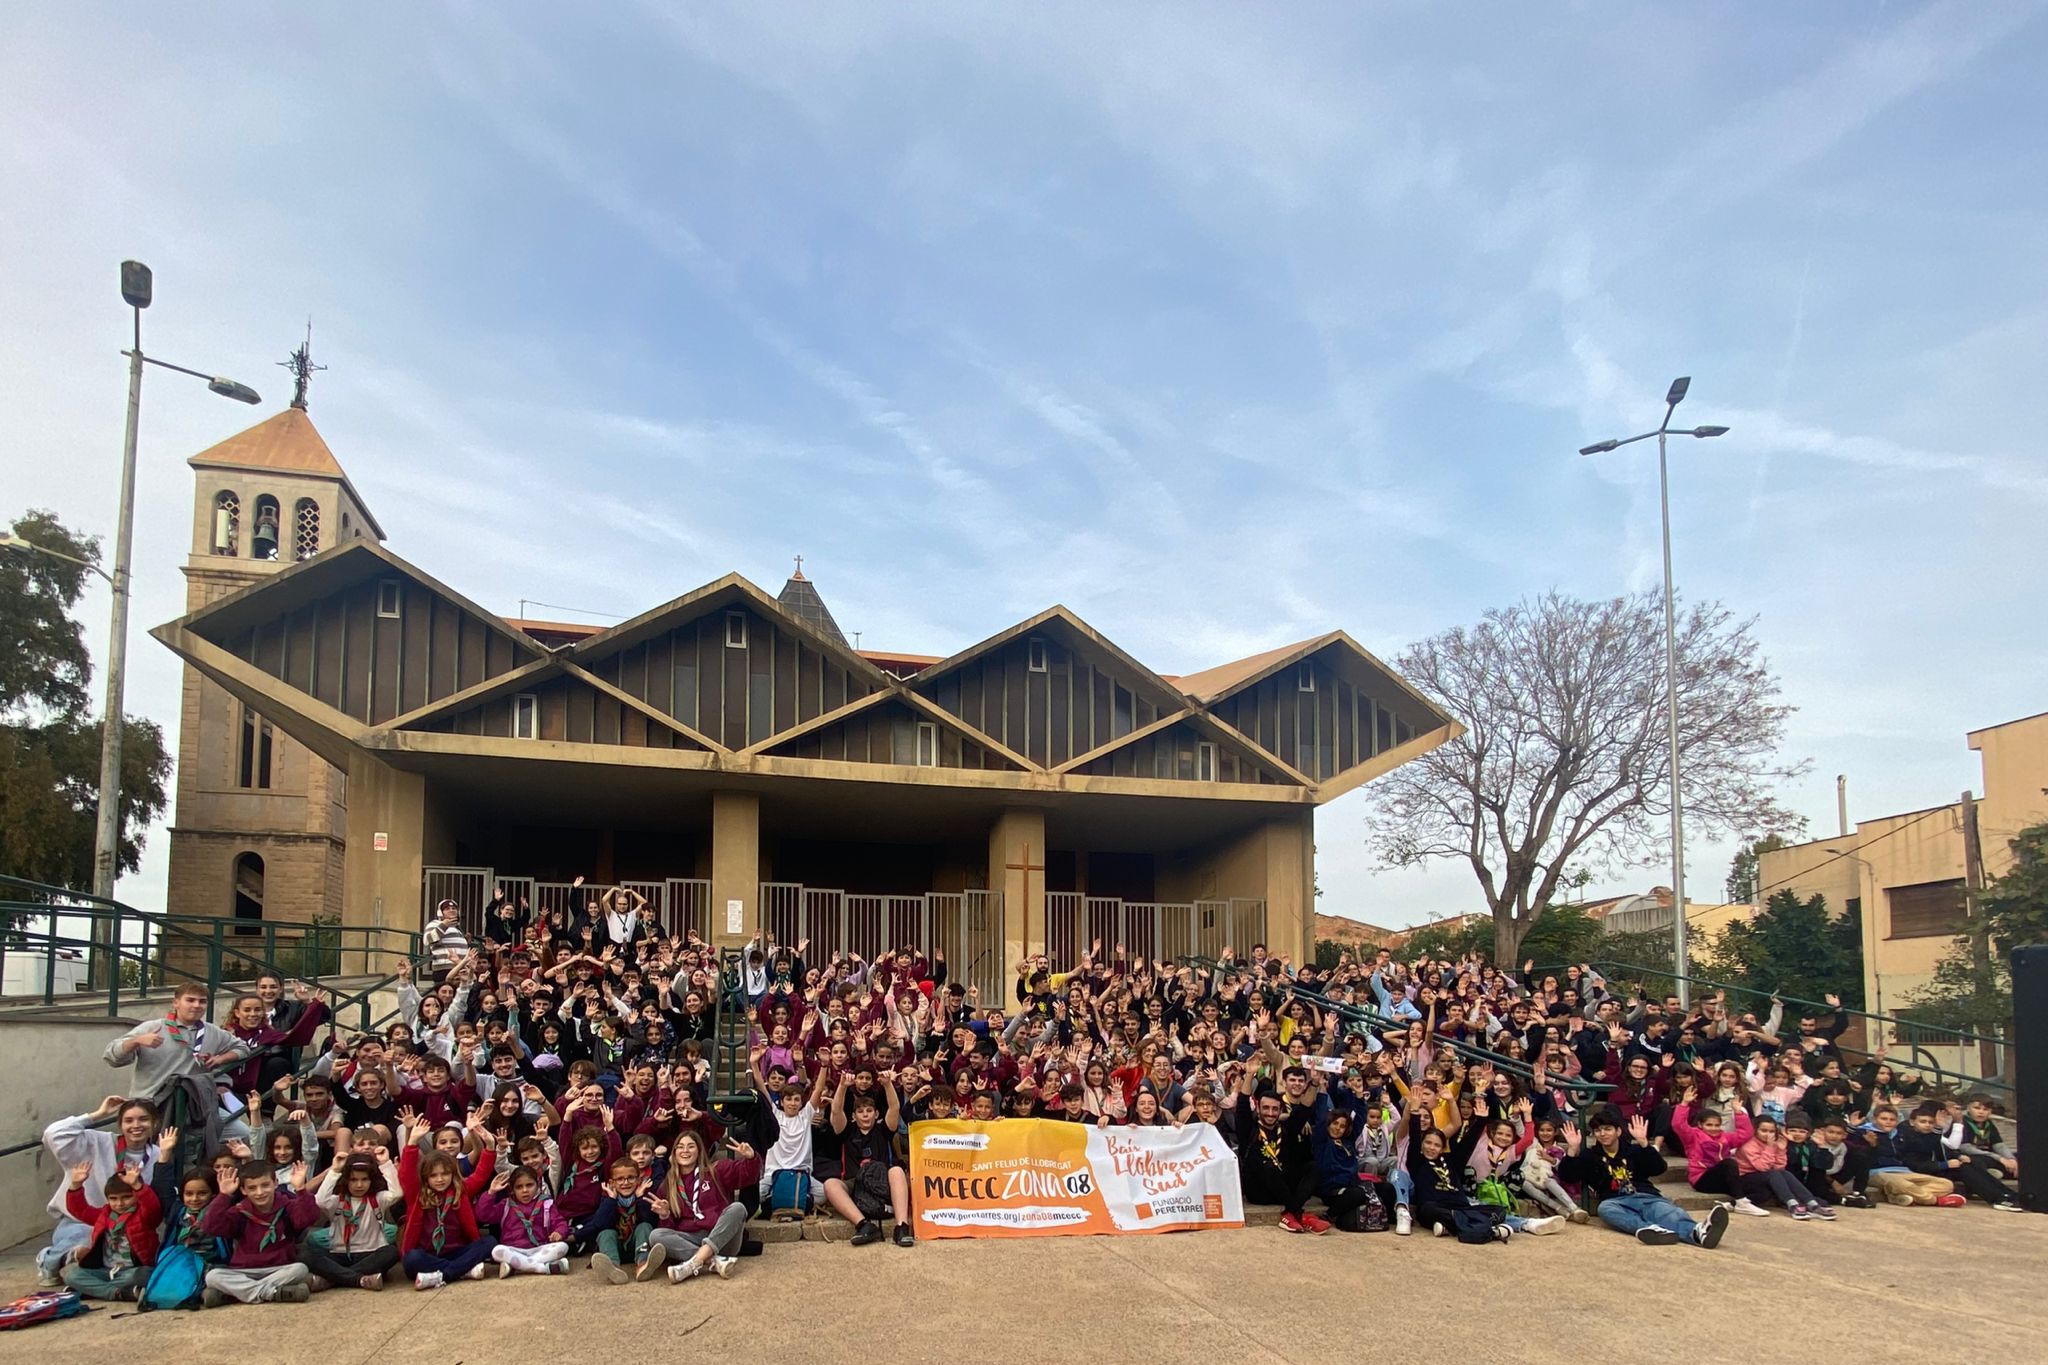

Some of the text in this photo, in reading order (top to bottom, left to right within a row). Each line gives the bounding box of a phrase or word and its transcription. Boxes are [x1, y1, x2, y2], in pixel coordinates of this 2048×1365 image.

[923, 1158, 964, 1171] TERRITORI
[972, 1162, 993, 1172] SANT
[994, 1159, 1018, 1169] FELIU
[1019, 1157, 1030, 1166] DE
[1113, 1146, 1215, 1176] Llobregat
[924, 1175, 1000, 1200] MCECC
[1067, 1174, 1091, 1194] 08
[1142, 1172, 1187, 1195] Sud
